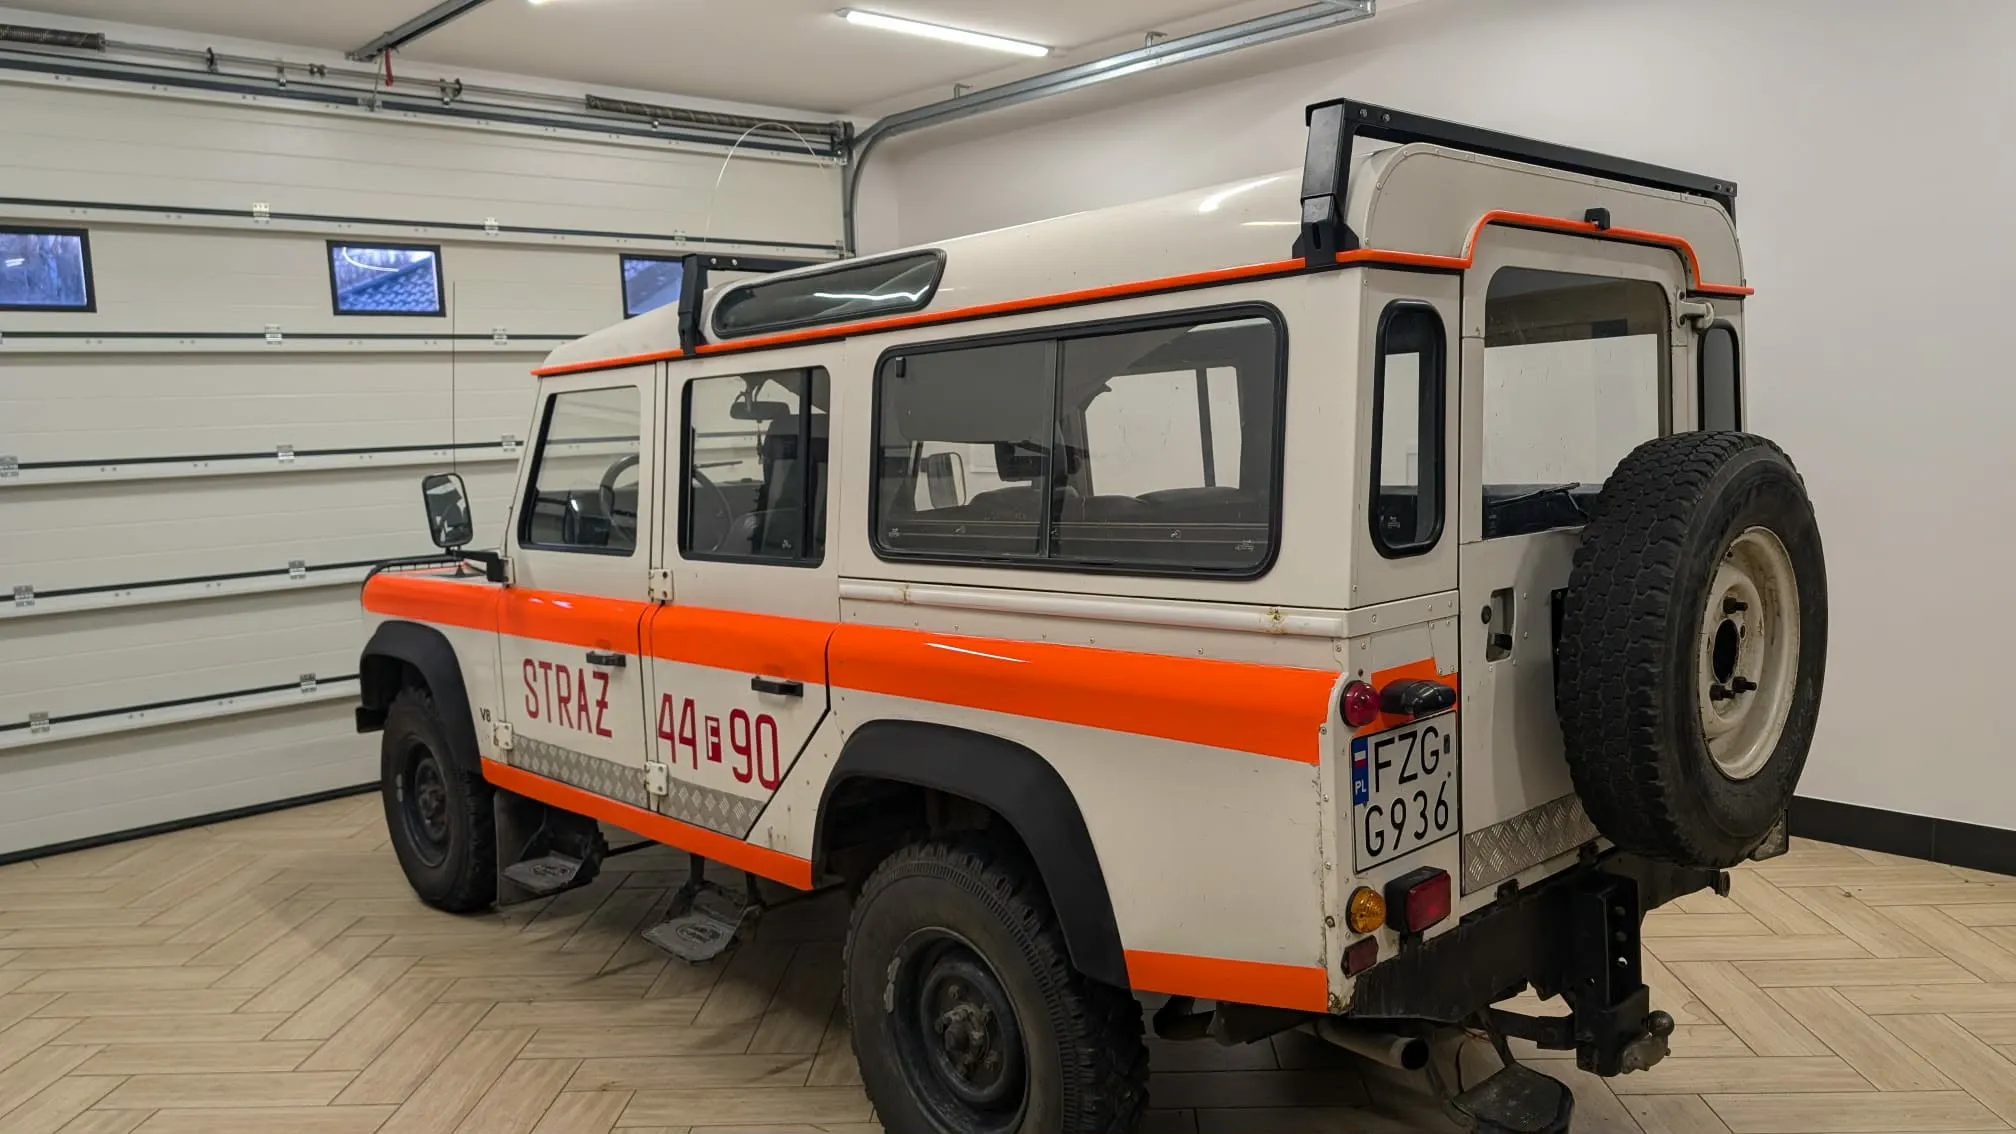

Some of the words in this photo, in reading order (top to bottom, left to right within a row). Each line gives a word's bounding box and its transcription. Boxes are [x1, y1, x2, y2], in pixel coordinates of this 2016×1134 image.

[522, 657, 613, 738] STRAŻ
[1354, 779, 1367, 795] PL
[1373, 725, 1440, 793] FZG
[1364, 780, 1449, 857] G936
